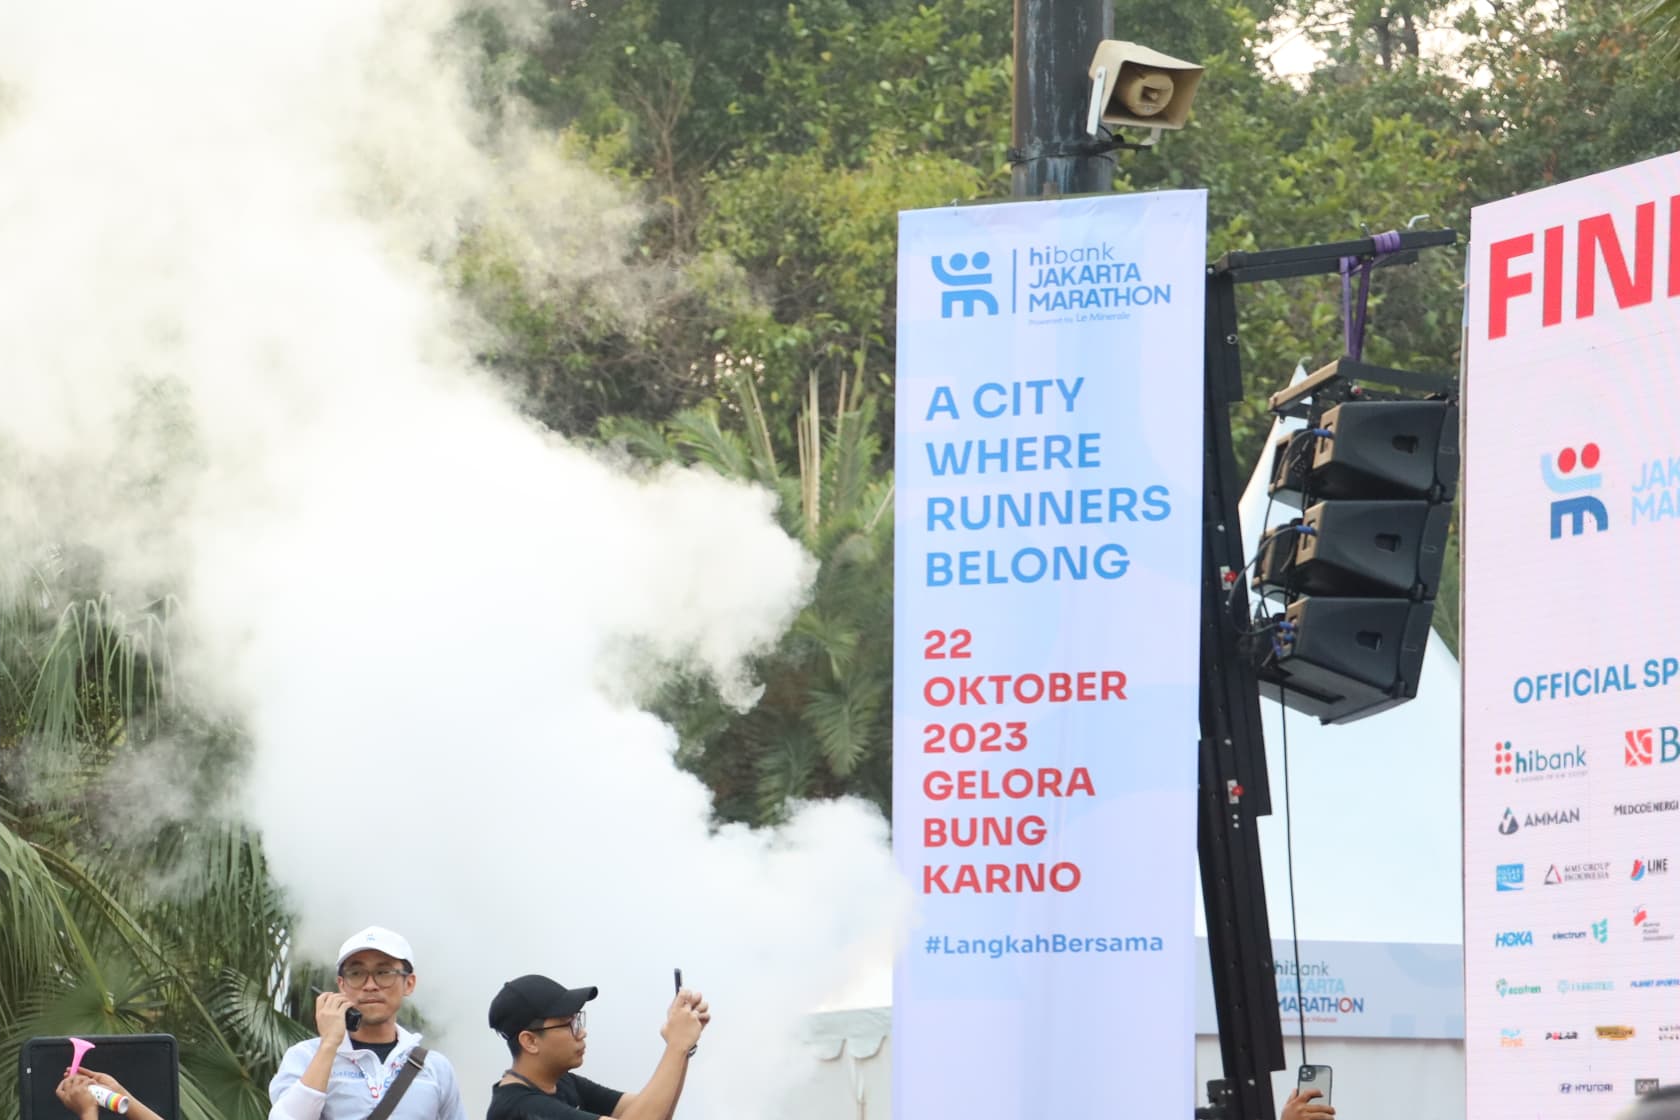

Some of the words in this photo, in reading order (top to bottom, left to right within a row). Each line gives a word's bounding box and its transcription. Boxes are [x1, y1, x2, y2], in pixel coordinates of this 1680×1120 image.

[1029, 242, 1114, 268] hibank
[1029, 262, 1142, 290] JAKARTA
[1028, 284, 1172, 314] MARATHON
[925, 385, 961, 422] A
[972, 377, 1085, 419] CITY
[925, 432, 1101, 477] WHERE
[926, 485, 1172, 532] RUNNERS
[1631, 487, 1680, 526] MA
[926, 543, 1131, 588] BELONG
[923, 628, 973, 660] 22
[923, 670, 1128, 708] OKTOBER
[1513, 663, 1638, 704] OFFICIAL
[1643, 656, 1680, 689] SP
[923, 721, 1028, 754] 2023
[1516, 744, 1587, 775] hibank
[923, 766, 1096, 801] GELORA
[923, 814, 1048, 848] BUNG
[1524, 808, 1580, 827] AMMAN
[922, 860, 1081, 895] KARNO
[924, 932, 1164, 960] #LangkahBersama
[1495, 930, 1533, 947] HOKA
[1277, 996, 1364, 1013] MARATHON
